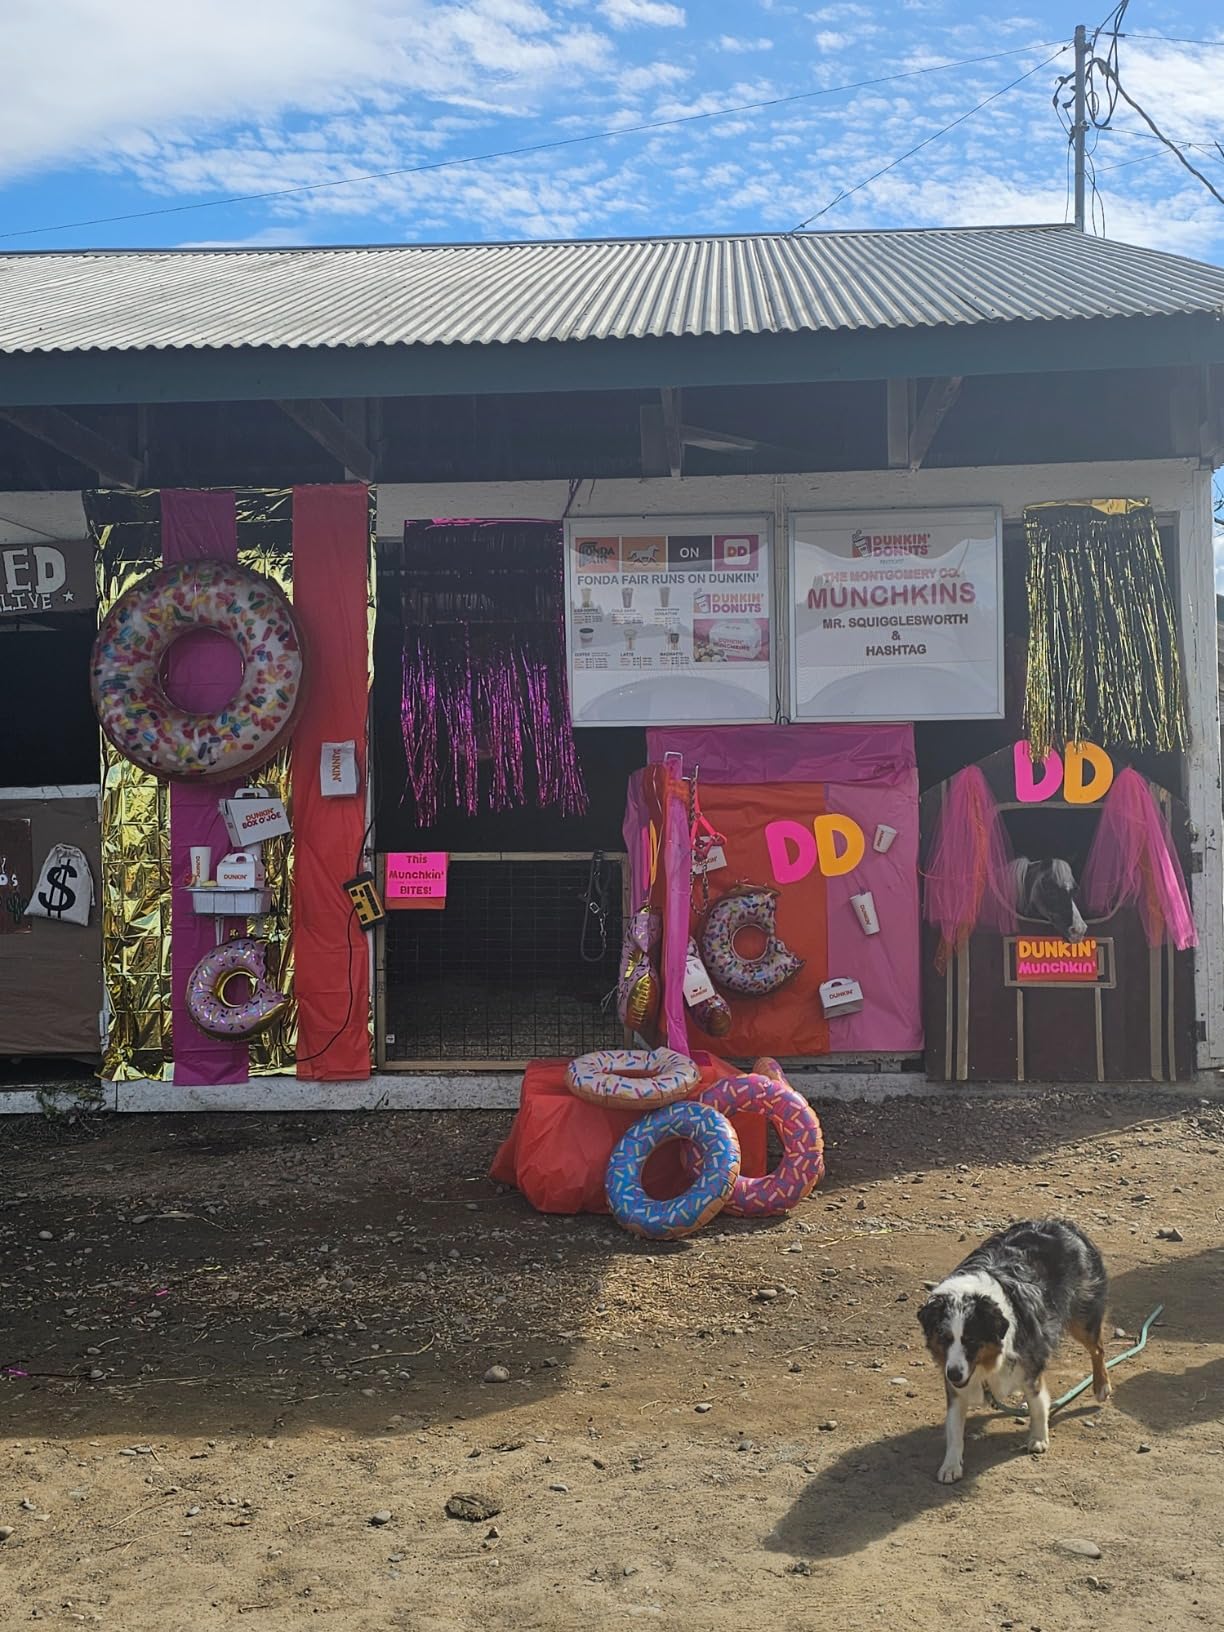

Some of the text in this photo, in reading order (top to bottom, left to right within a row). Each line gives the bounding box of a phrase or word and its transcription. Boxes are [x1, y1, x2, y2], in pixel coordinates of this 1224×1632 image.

[873, 533, 931, 546] DUNKIN'
[680, 547, 699, 558] ON
[727, 545, 748, 557] DD
[873, 545, 930, 557] DONUTS
[577, 572, 759, 585] FONDA FAIR RUNS ON DUNKIN'
[824, 567, 961, 582] THE MONTGOMERY CO.
[712, 593, 764, 603] DUNKIN'
[807, 582, 976, 609] MUNCHKINS
[712, 603, 762, 613] DONUTS
[822, 613, 969, 629] MR. SQUIGGLESWORTH
[891, 630, 901, 640] &
[866, 644, 927, 656] HASHTAG
[332, 749, 341, 782] DUNKIN'
[1014, 739, 1114, 804] DD
[245, 807, 274, 822] DUNKIN'
[242, 819, 258, 829] BOX
[765, 814, 865, 884] DD
[406, 854, 428, 864] This
[400, 885, 432, 895] BITES!
[1018, 940, 1096, 959] DUNKIN'
